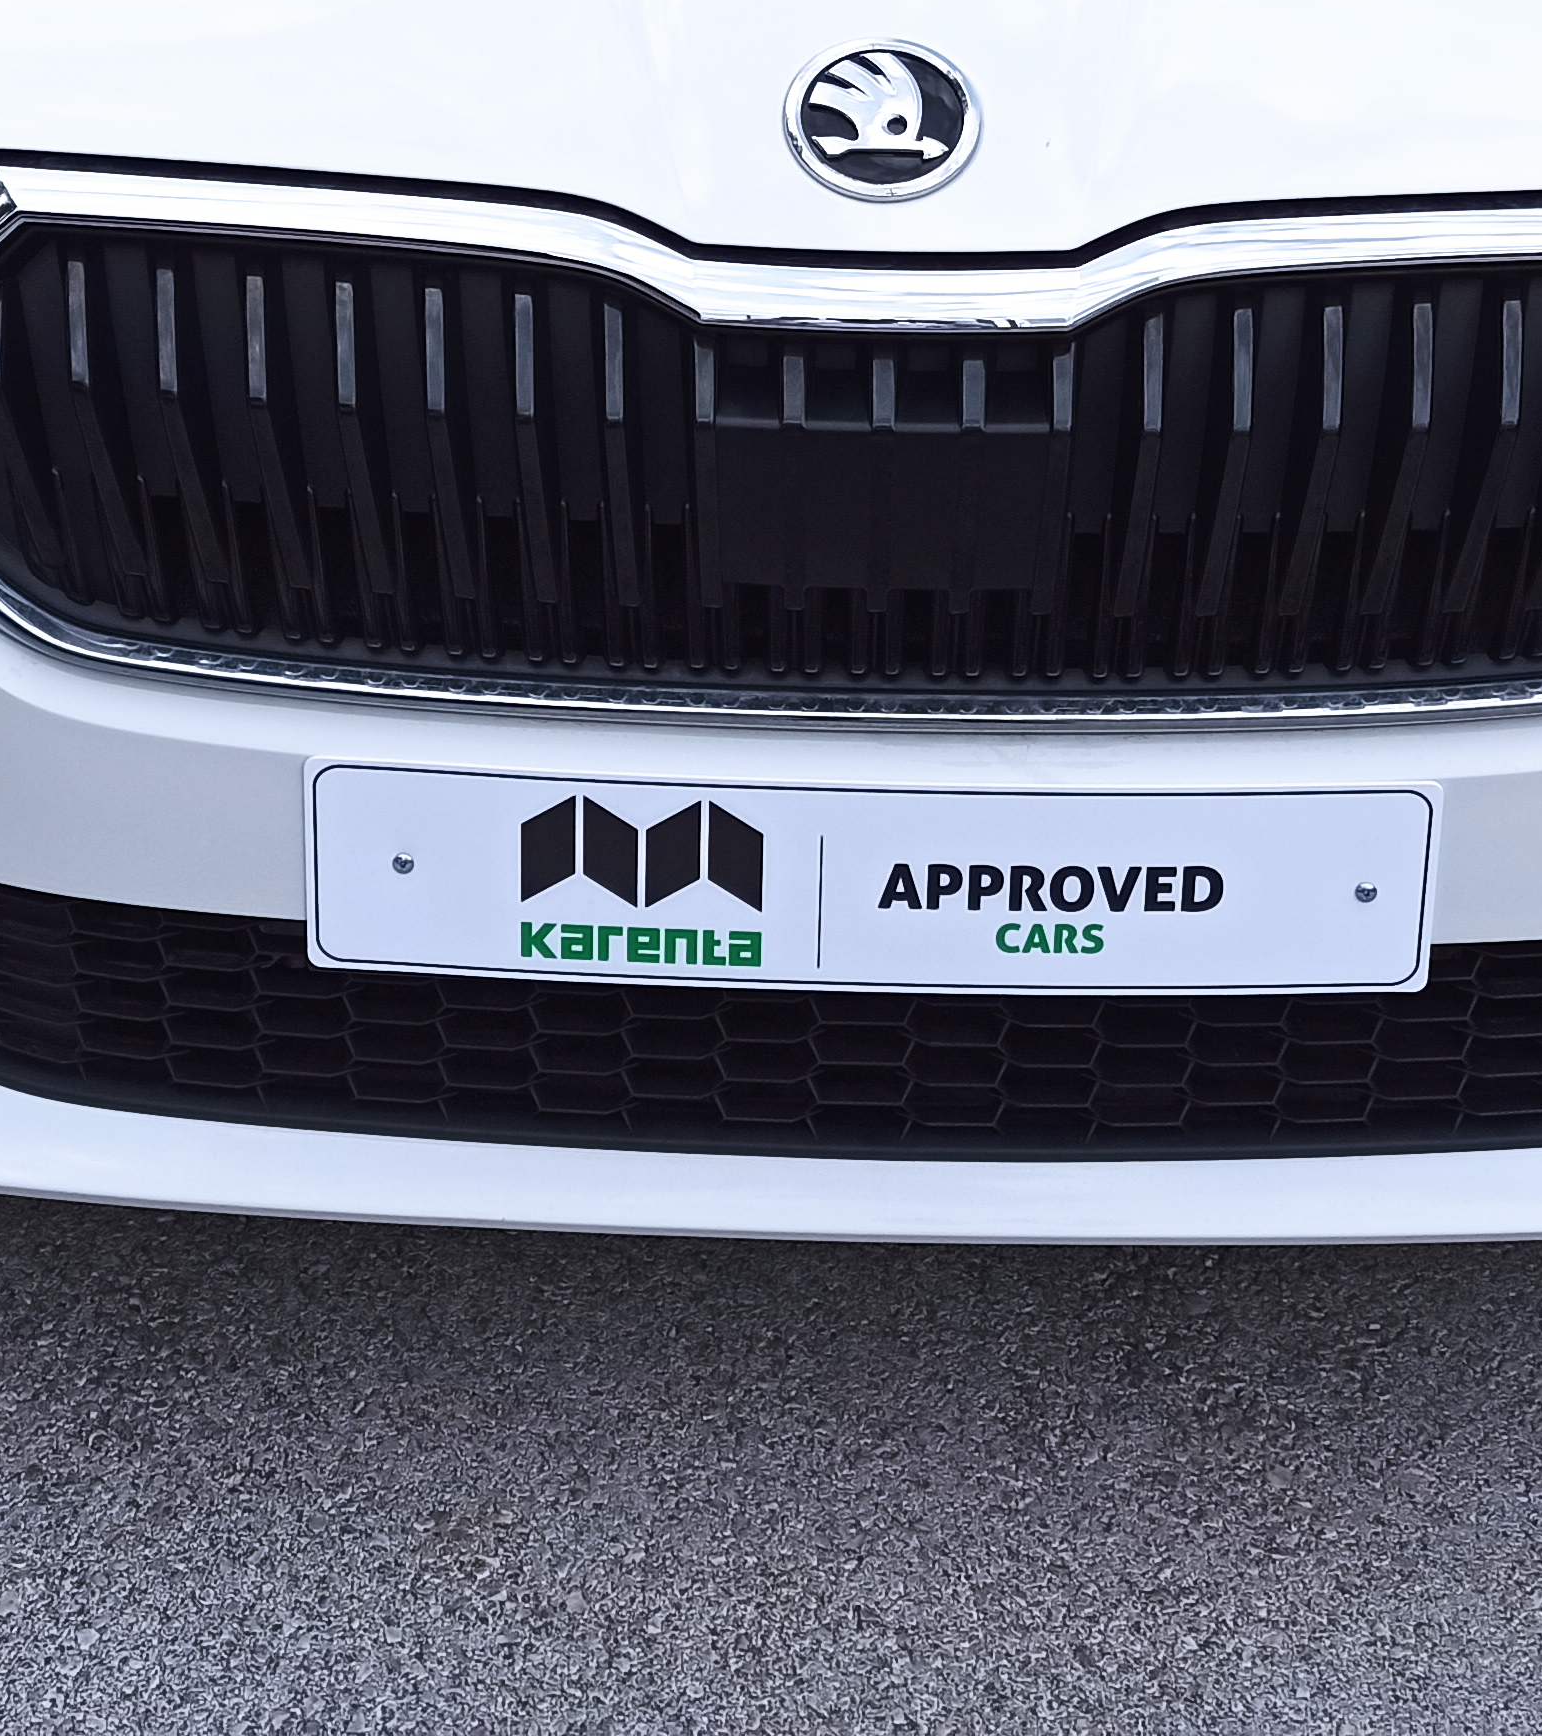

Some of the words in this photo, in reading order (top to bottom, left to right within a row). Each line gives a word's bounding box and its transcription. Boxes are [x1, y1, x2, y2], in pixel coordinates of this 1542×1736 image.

[878, 863, 1224, 913] APPROVED
[520, 921, 762, 967] Karenta
[995, 923, 1105, 954] CARS
